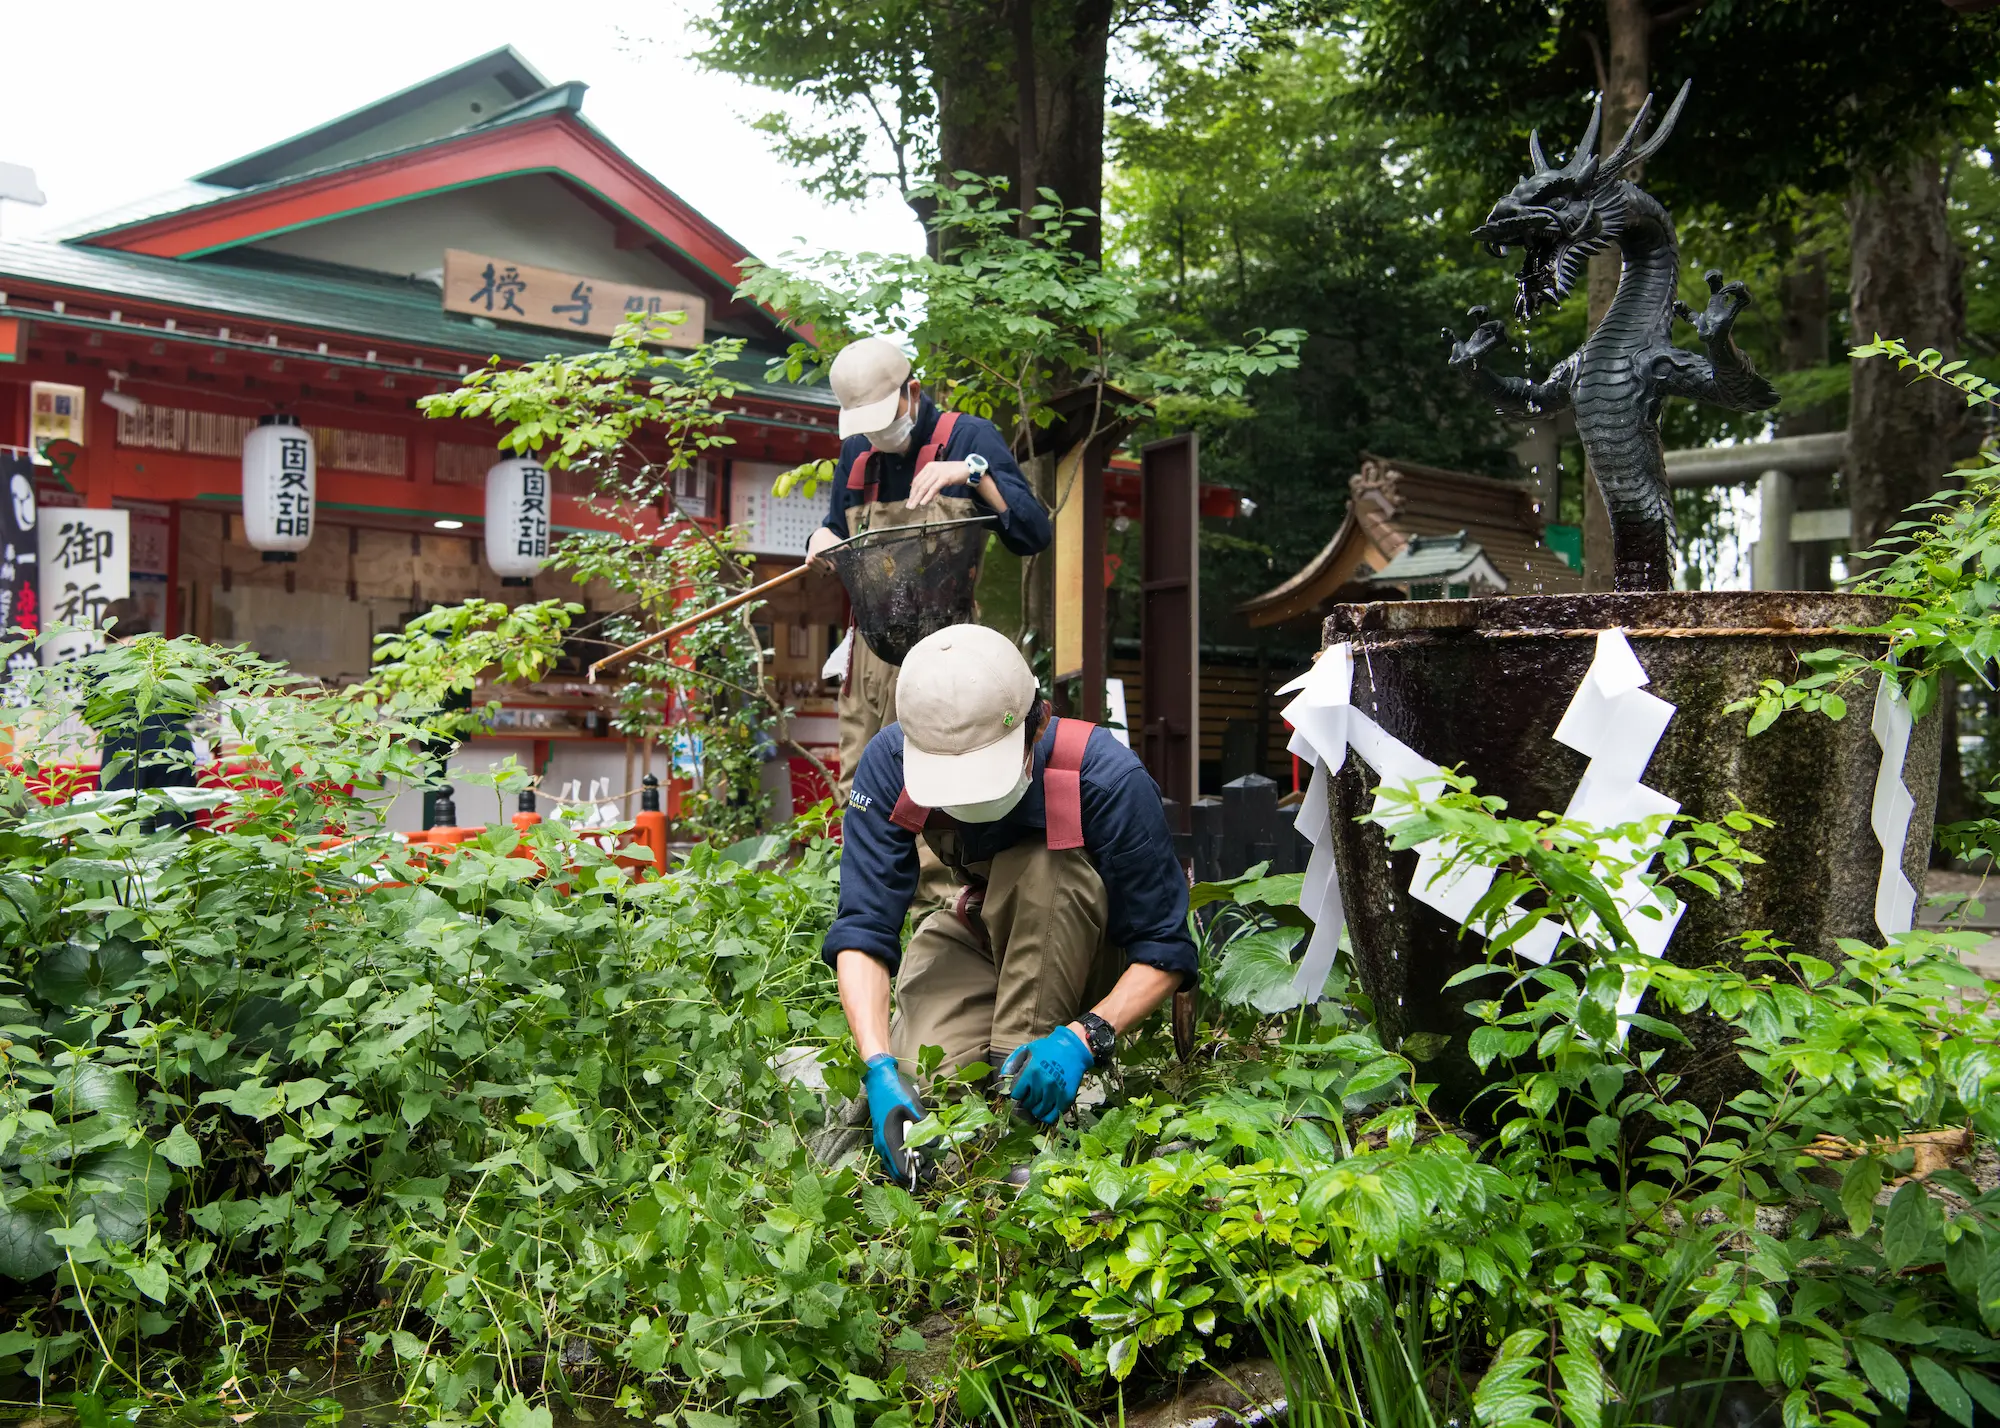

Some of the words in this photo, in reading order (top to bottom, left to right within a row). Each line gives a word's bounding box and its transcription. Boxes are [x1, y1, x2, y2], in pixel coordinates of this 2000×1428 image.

[276, 437, 310, 537] 夏詣
[518, 467, 547, 557] 夏詣
[51, 521, 114, 692] 御祈
